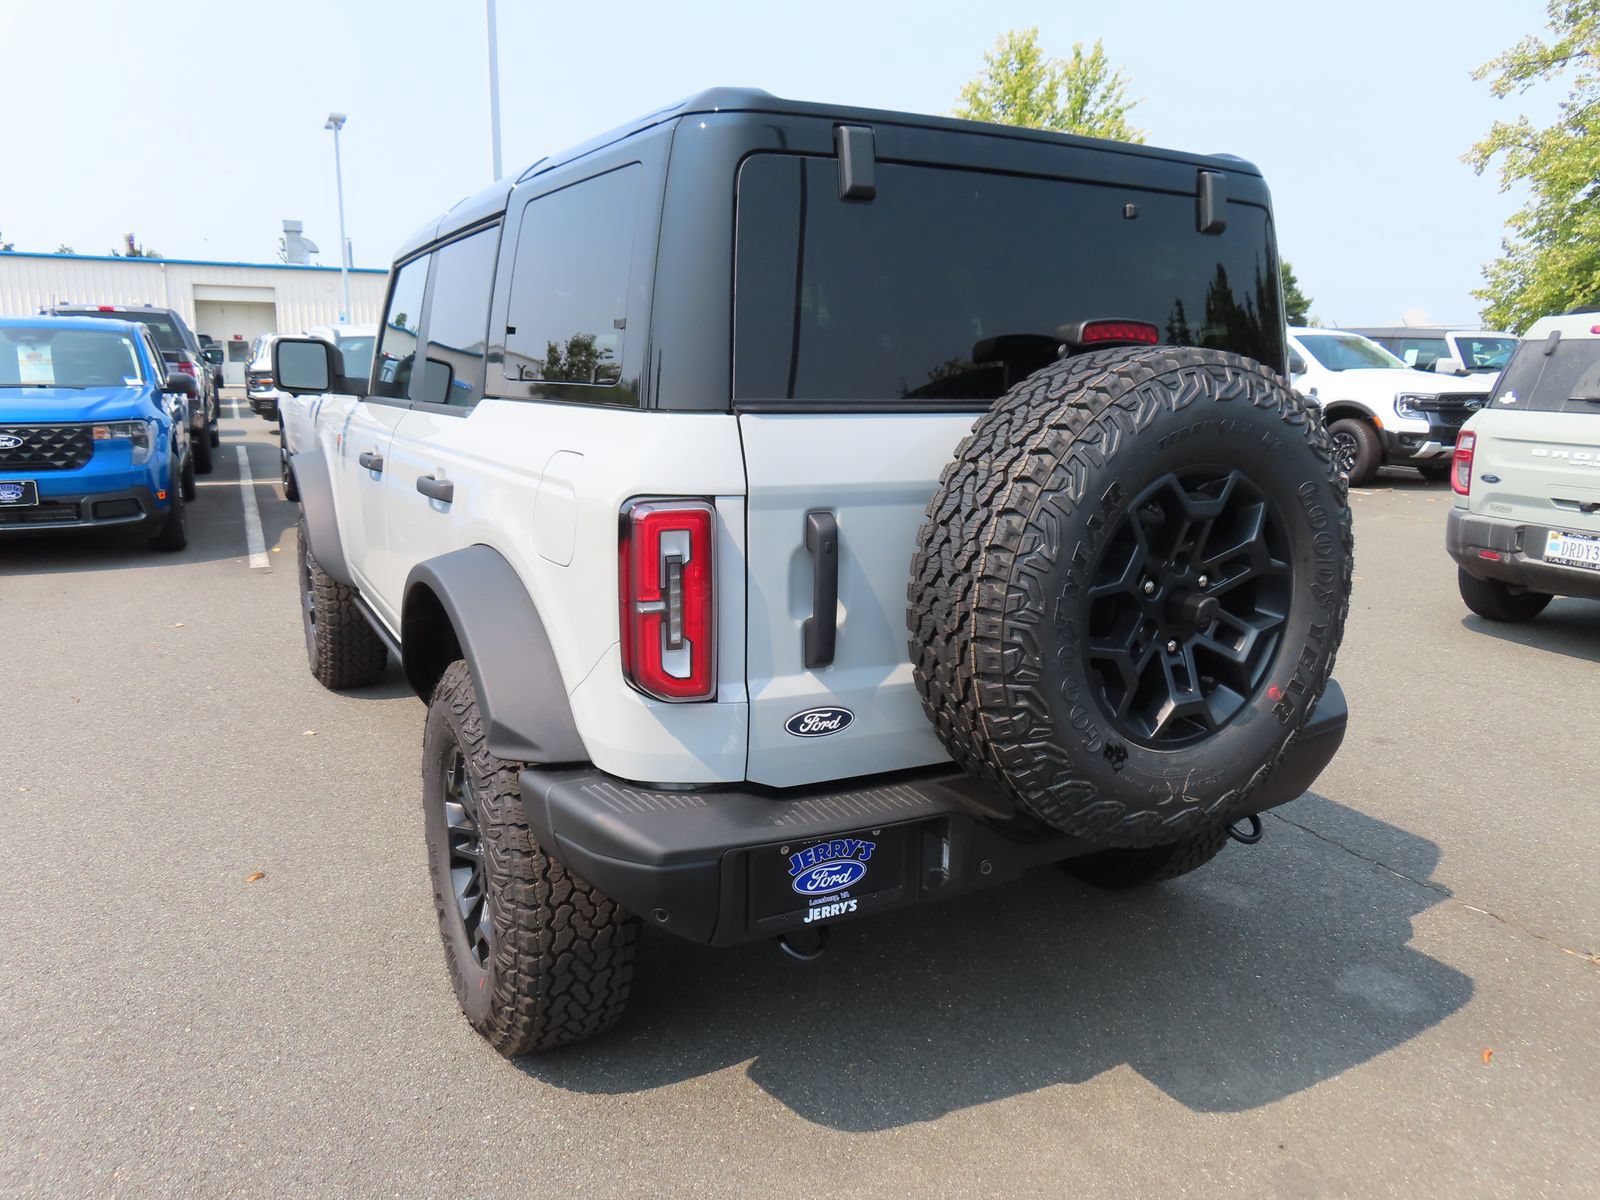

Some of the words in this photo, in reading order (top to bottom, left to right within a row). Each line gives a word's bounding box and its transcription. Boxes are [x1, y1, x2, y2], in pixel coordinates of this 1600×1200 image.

[1271, 480, 1337, 726] GOODYEAR
[799, 712, 842, 733] Ford
[788, 839, 877, 876] JERRY'S
[806, 865, 853, 890] Ford
[803, 899, 858, 923] JERRY'S
